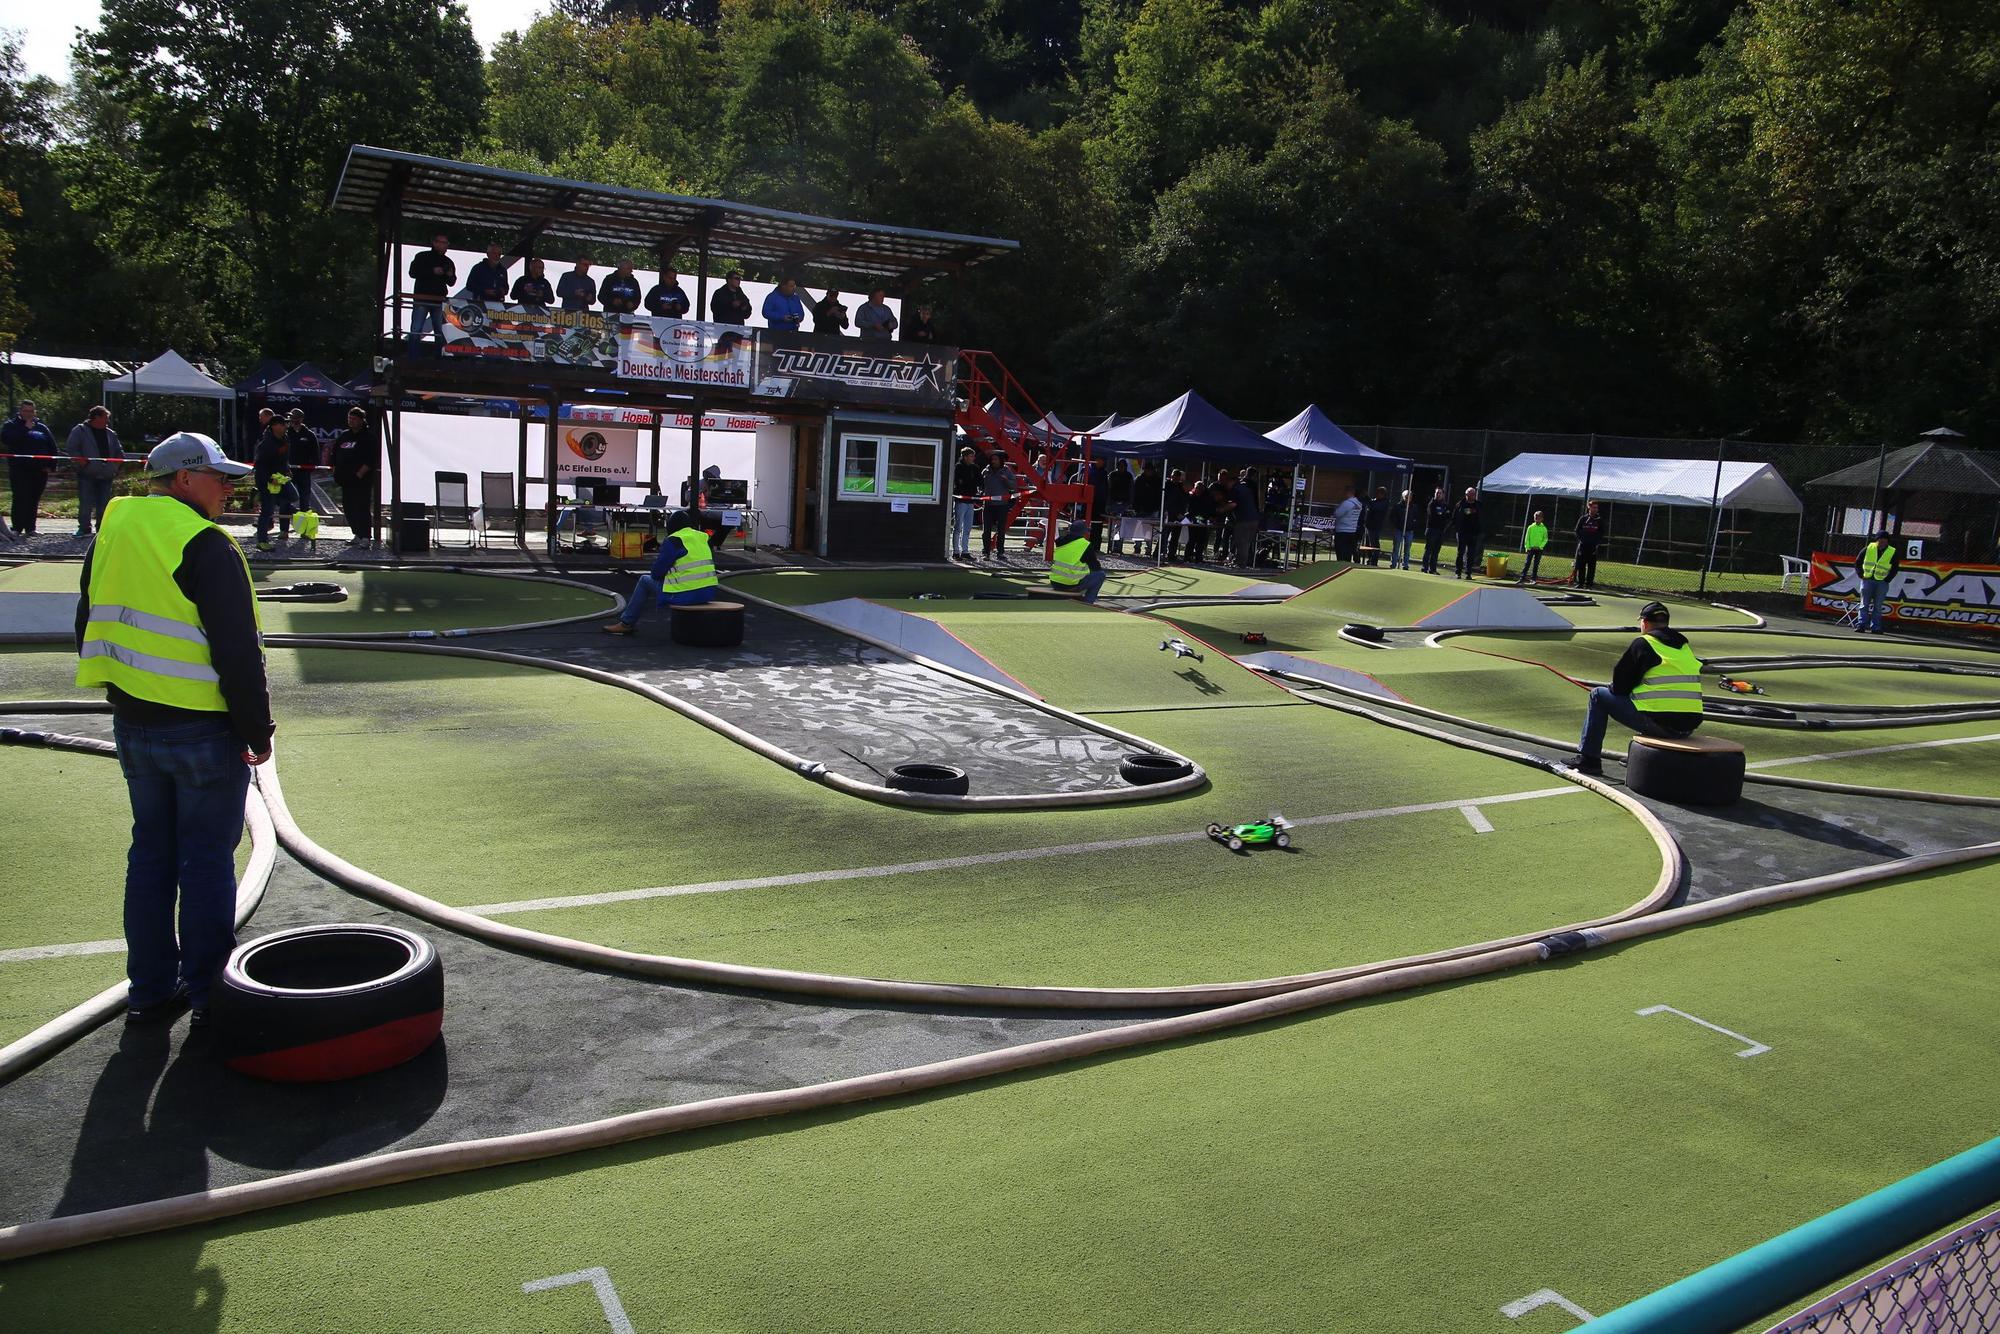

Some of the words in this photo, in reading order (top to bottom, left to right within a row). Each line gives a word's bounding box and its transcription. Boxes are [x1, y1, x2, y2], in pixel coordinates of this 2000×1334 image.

[551, 309, 577, 326] Eifel
[579, 313, 604, 329] Elos
[673, 328, 700, 341] DMC
[622, 359, 672, 379] Deutsche
[674, 363, 745, 385] Meisterschaft
[556, 464, 570, 472] AC
[572, 464, 592, 473] Eifel
[594, 465, 612, 473] Elos
[613, 466, 630, 474] e.V.
[1909, 546, 1918, 557] 6
[1899, 607, 2000, 623] CHAMPI
